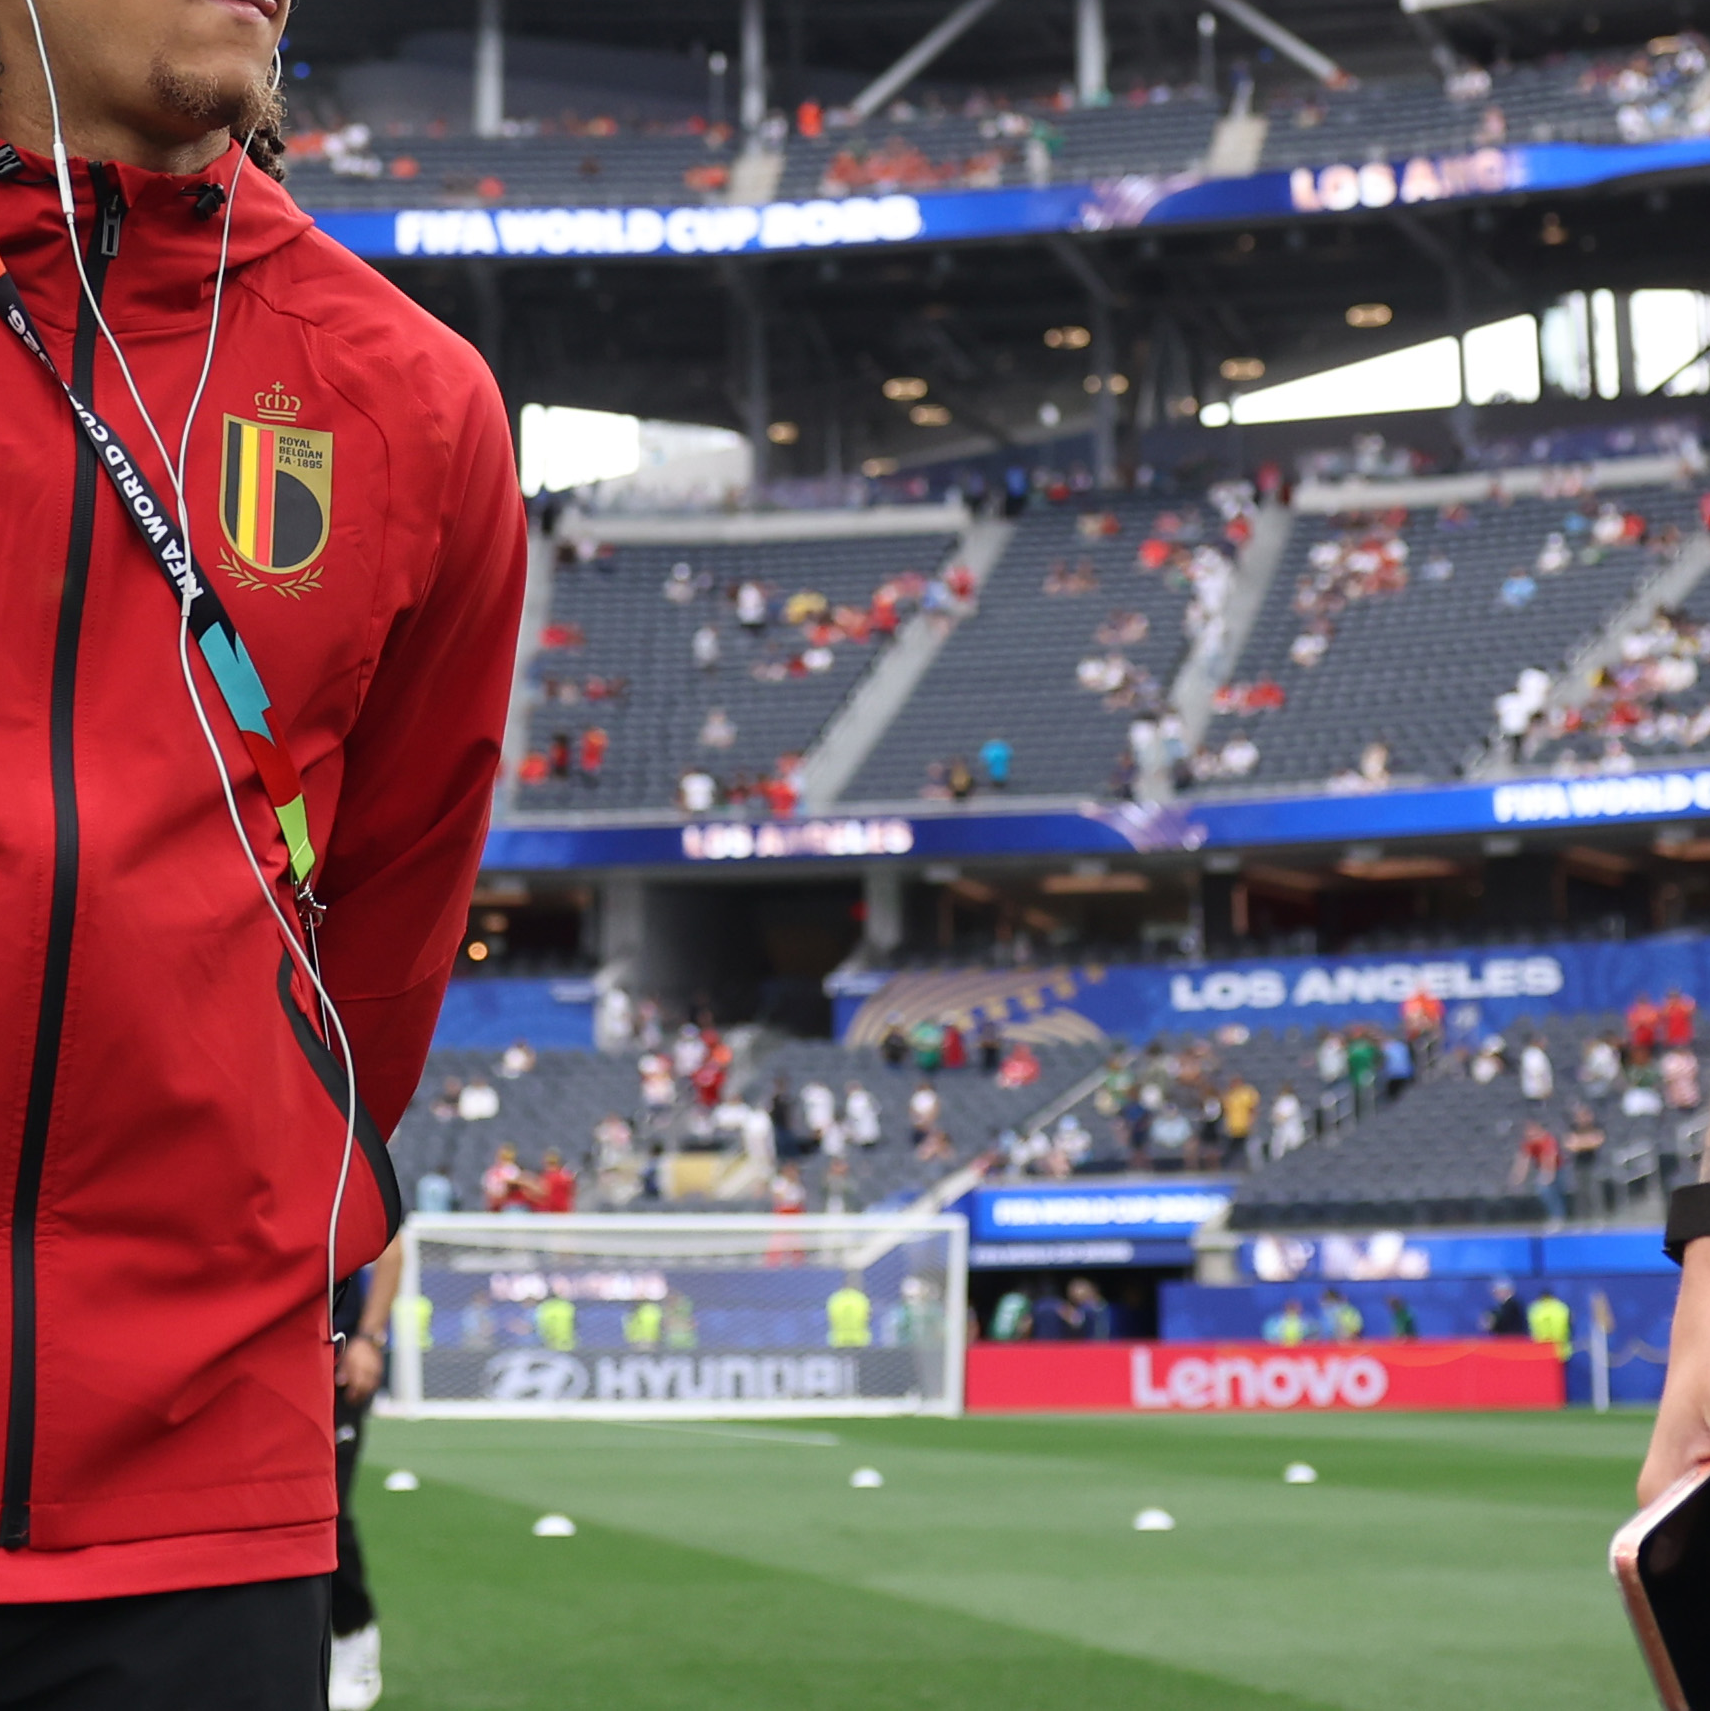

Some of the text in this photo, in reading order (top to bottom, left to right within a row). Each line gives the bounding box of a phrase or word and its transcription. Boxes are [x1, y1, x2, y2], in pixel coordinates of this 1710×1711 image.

[394, 208, 497, 256] FIFA
[496, 206, 666, 255] WORLD
[664, 204, 761, 254] CUP
[278, 445, 323, 459] BELGIAN
[279, 435, 312, 449] ROYAL
[104, 443, 169, 544] WORLD
[1492, 782, 1572, 824] FIFA
[1569, 773, 1693, 819] WORLD
[1169, 955, 1564, 1013] LOS ANGELES
[594, 1353, 861, 1400] HYUNDAI
[1128, 1344, 1389, 1410] Lenovo
